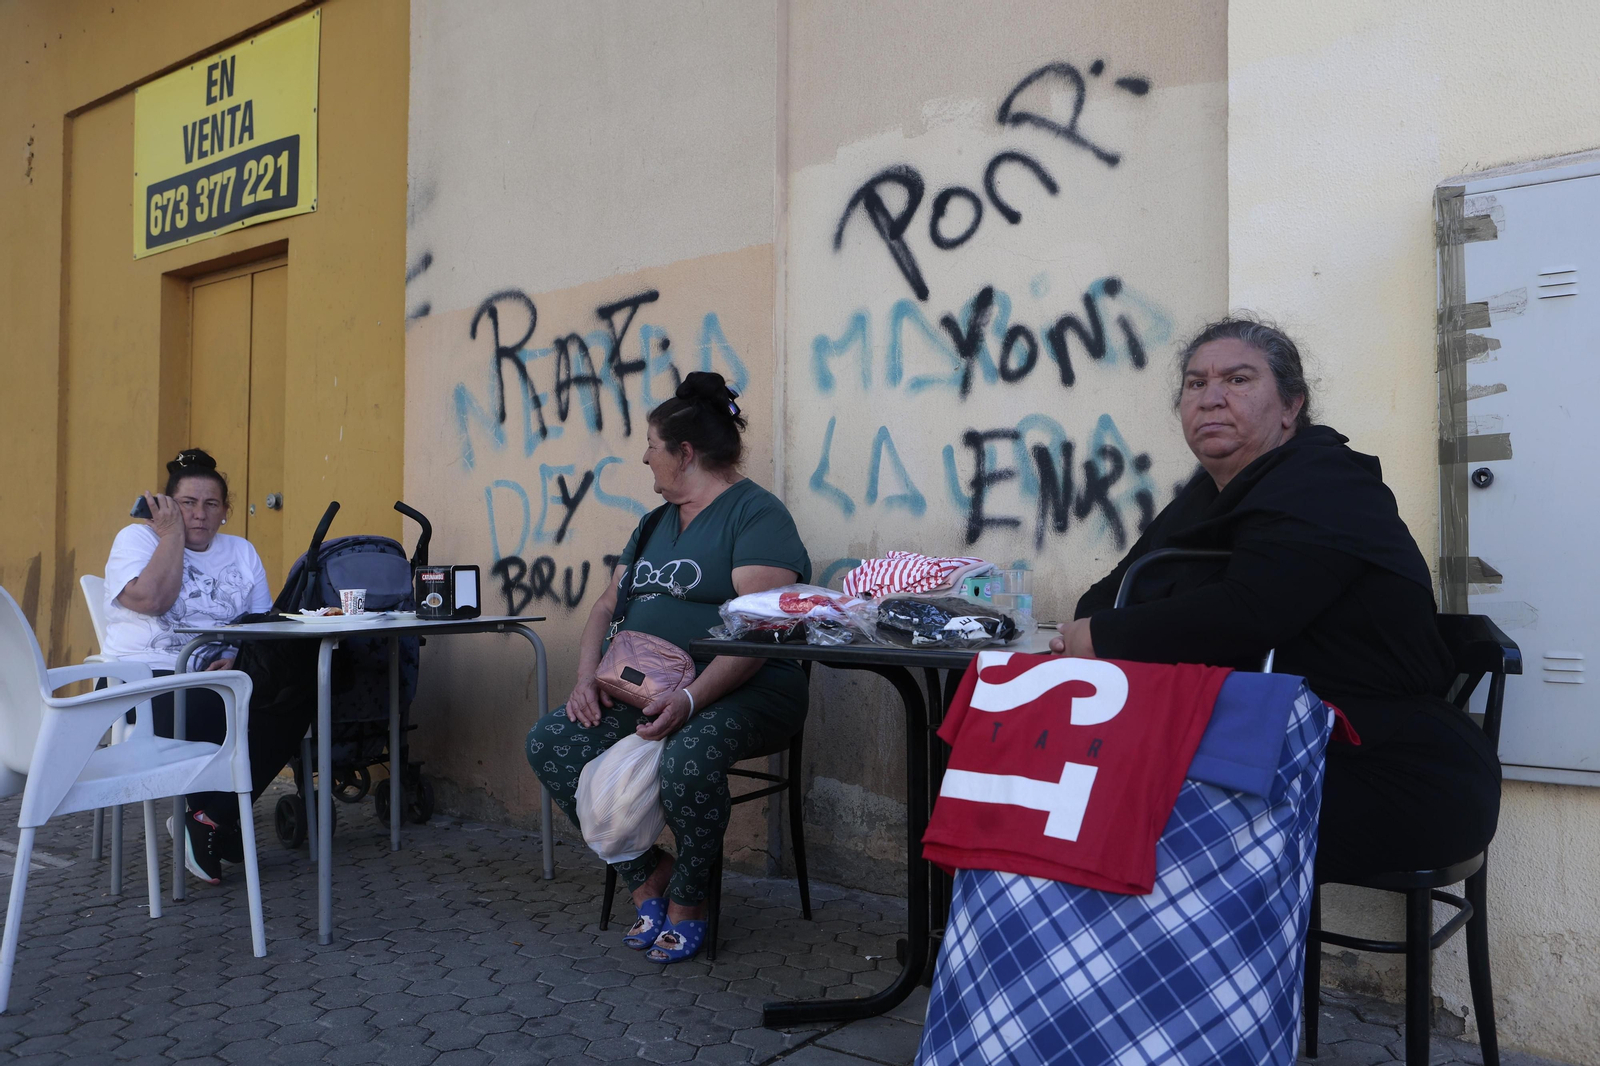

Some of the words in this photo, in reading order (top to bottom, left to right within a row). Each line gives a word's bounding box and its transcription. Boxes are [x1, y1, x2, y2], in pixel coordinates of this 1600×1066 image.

[206, 55, 236, 106] EN
[183, 99, 254, 165] VENTA
[150, 185, 189, 236] 673
[195, 167, 236, 223] 377
[242, 150, 289, 207] 221
